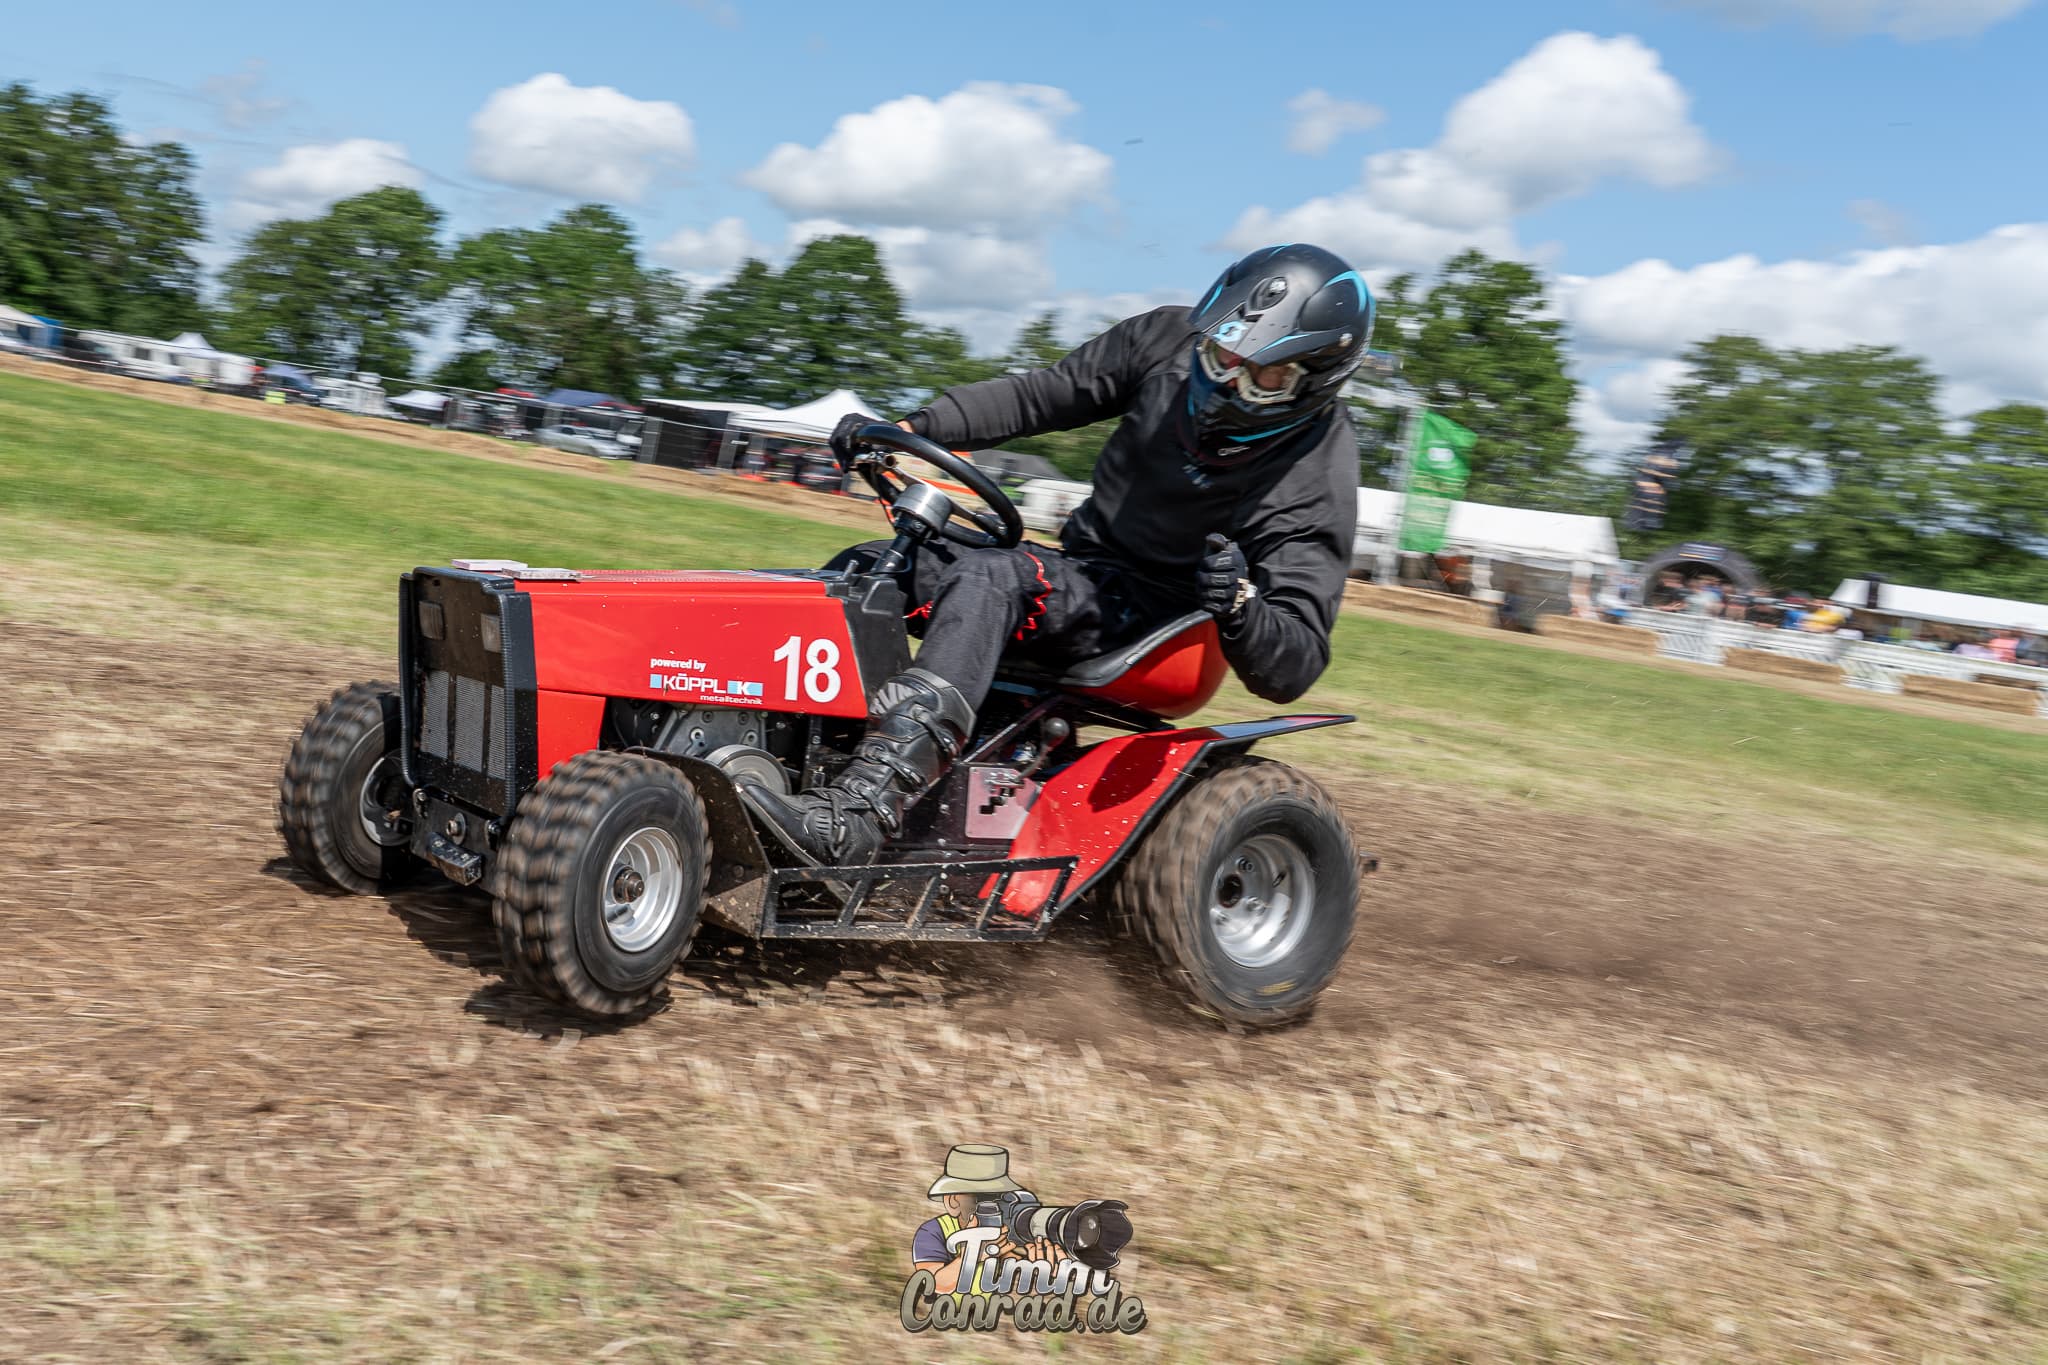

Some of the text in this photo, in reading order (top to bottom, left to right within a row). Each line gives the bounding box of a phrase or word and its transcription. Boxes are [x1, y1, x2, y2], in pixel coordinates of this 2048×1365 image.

[650, 658, 706, 672] powered by
[774, 635, 841, 703] 18
[663, 673, 726, 694] KÖPPL
[700, 695, 763, 705] metalltechnik
